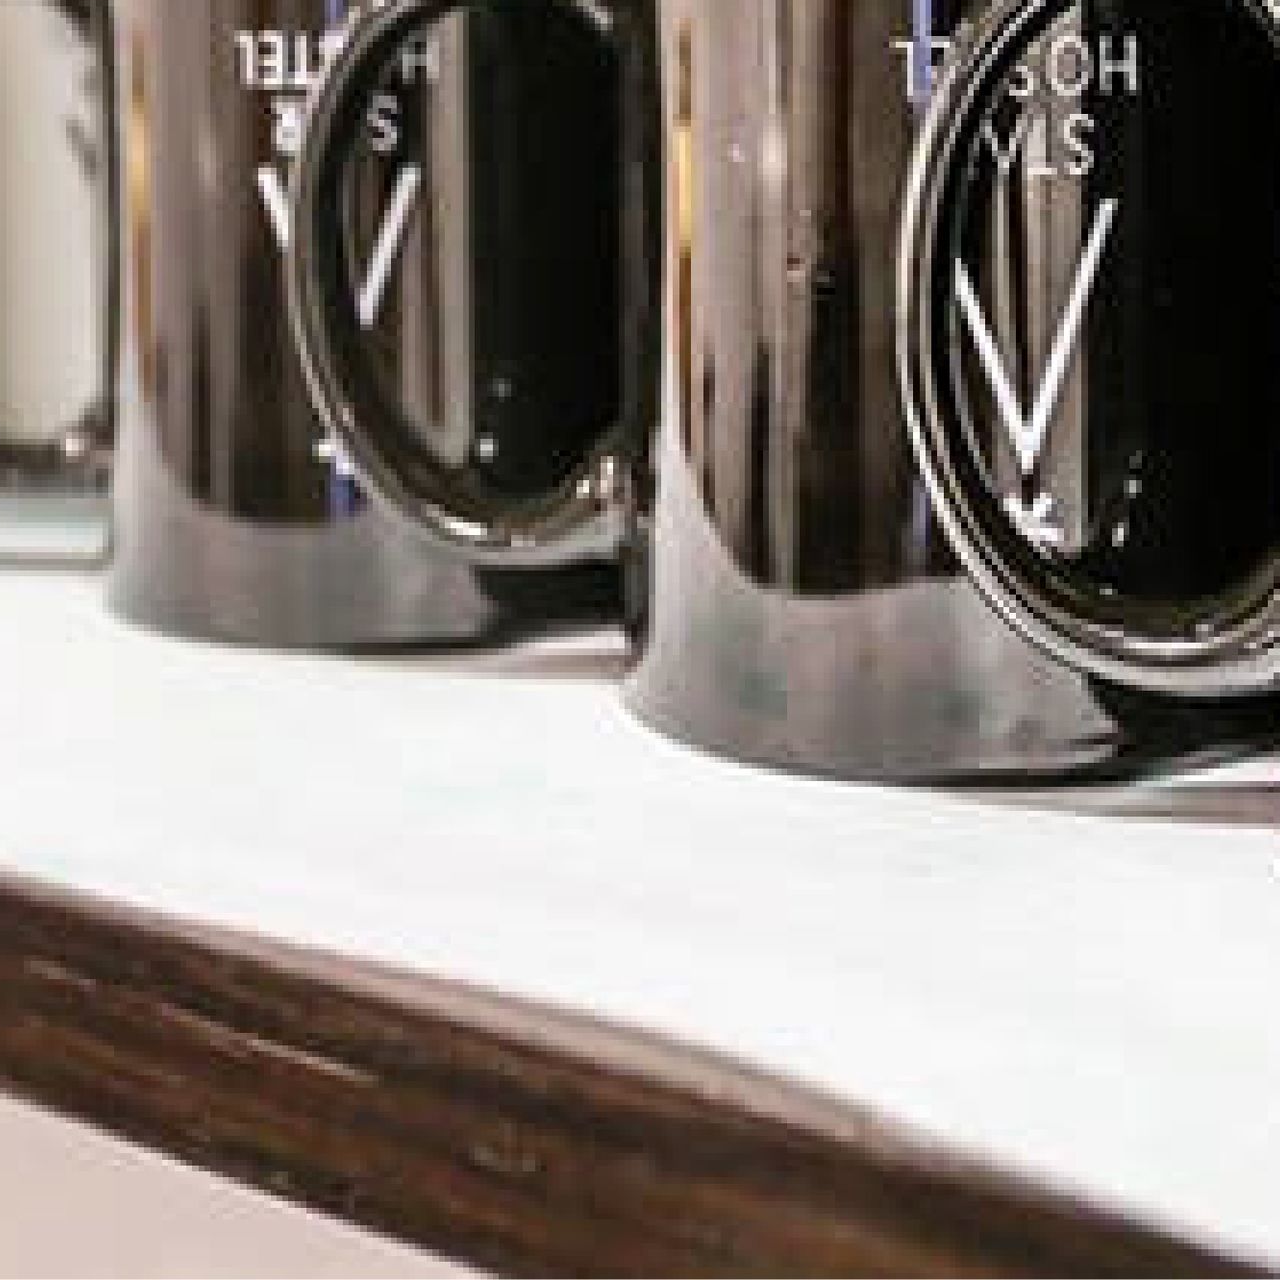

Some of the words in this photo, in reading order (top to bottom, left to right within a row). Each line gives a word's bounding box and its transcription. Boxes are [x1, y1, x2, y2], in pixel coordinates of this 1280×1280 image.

[233, 29, 440, 85] HTEL
[887, 33, 1138, 96] HOSL
[272, 94, 399, 152] SR
[970, 113, 1096, 176] STA
